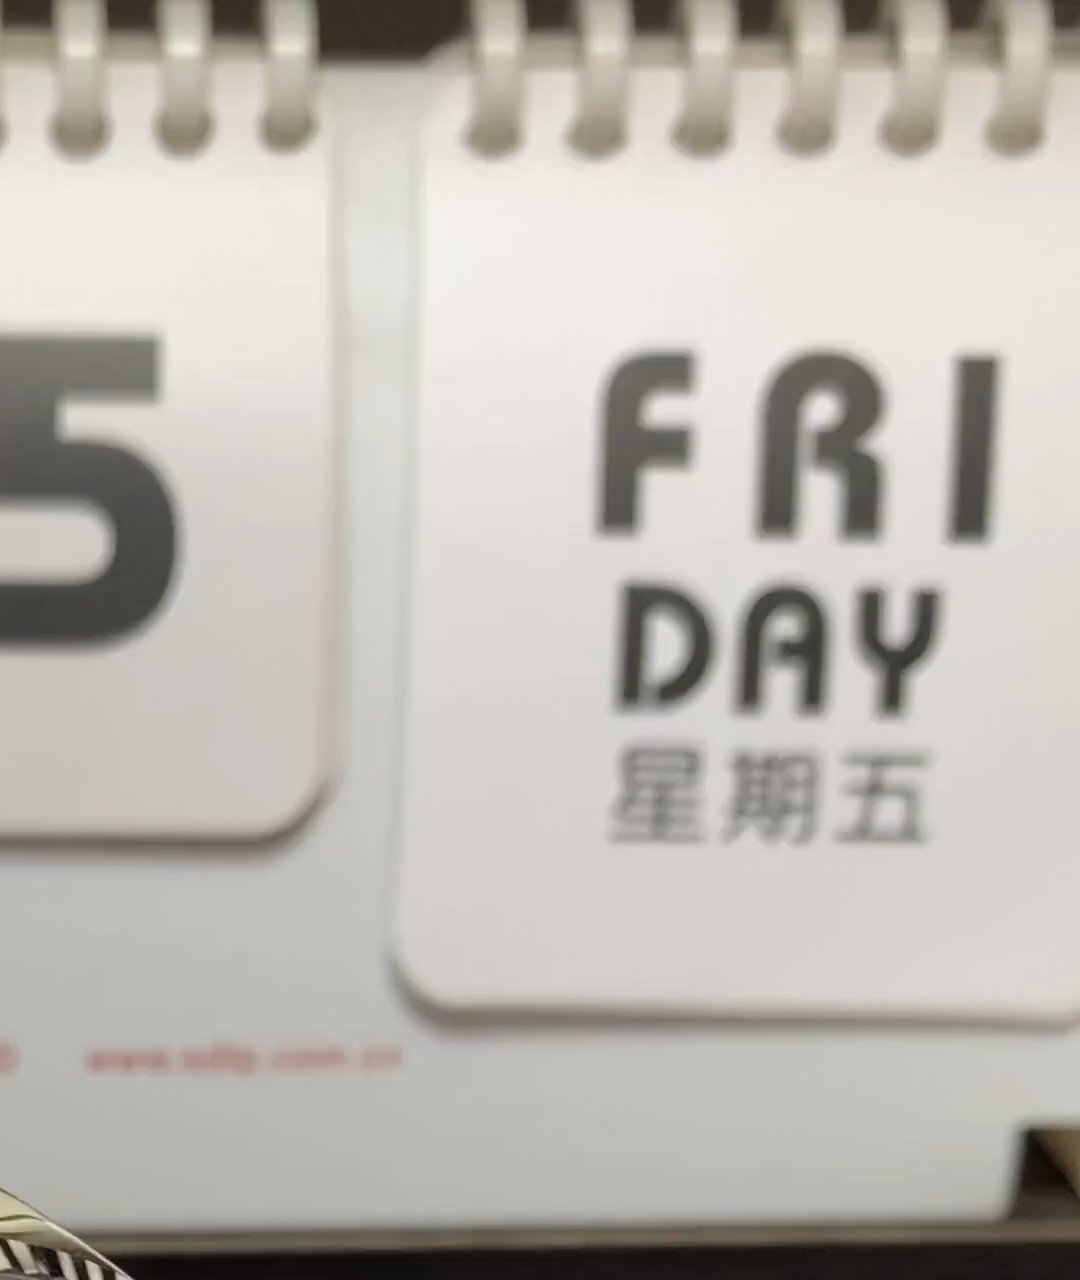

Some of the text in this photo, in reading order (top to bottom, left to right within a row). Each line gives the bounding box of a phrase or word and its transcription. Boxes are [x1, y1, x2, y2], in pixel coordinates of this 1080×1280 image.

[595, 350, 1001, 545] FRI
[614, 582, 944, 718] DAY
[608, 745, 931, 847] 星期五
